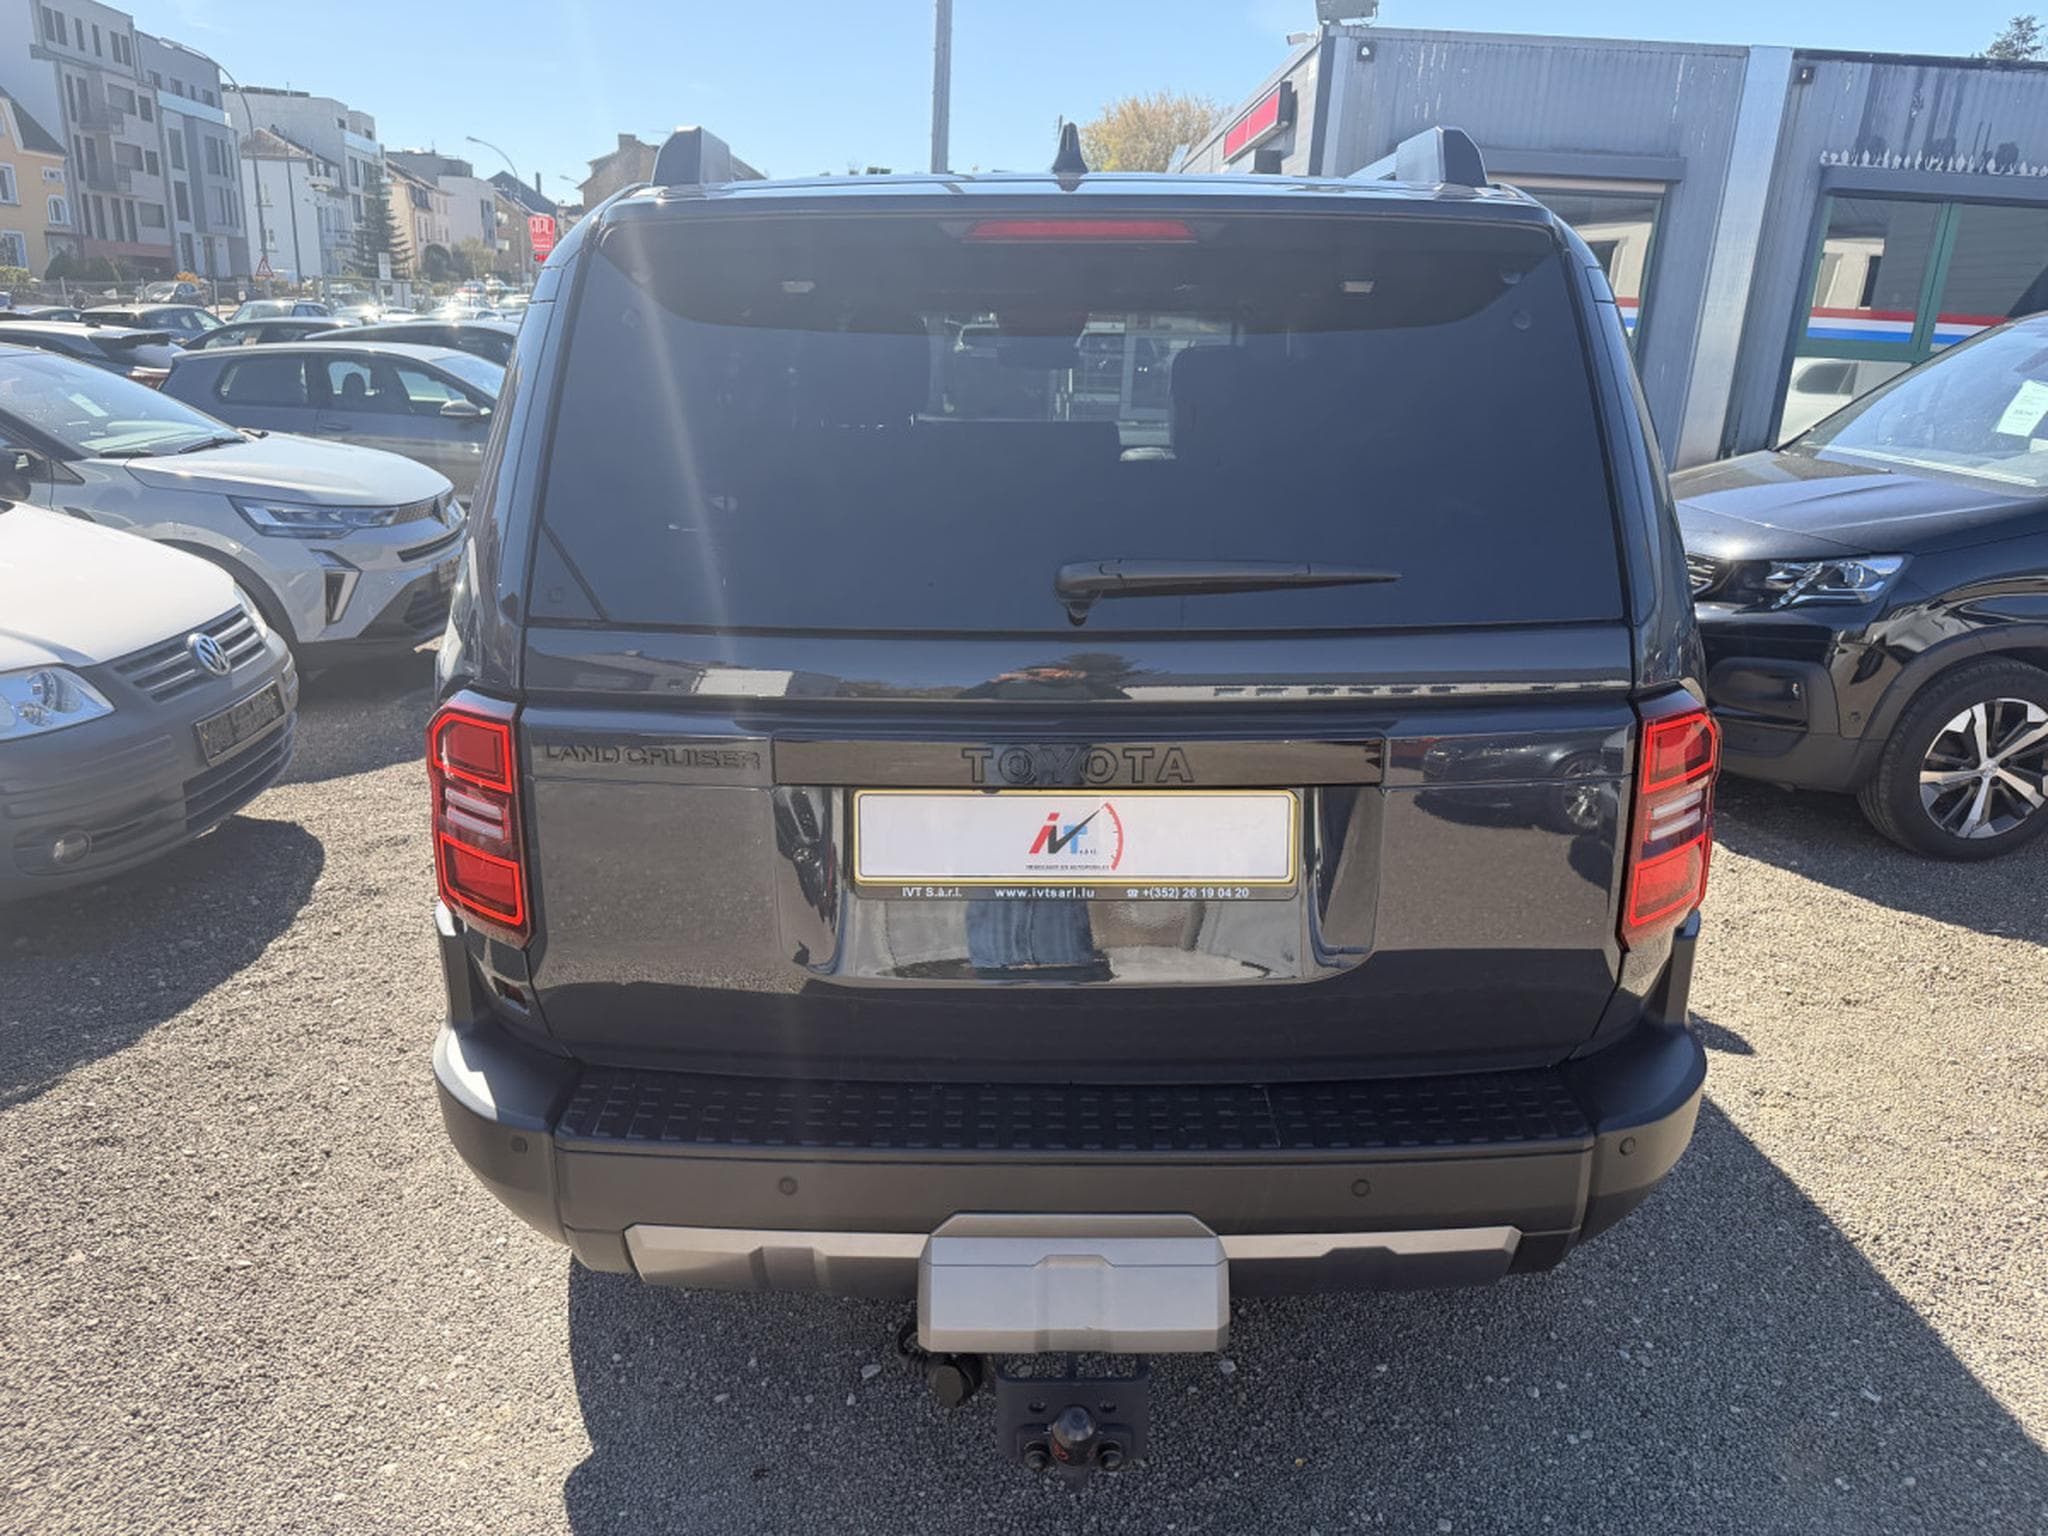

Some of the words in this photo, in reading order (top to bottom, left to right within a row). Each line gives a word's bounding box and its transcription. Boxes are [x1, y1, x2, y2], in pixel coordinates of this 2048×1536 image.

[546, 745, 620, 764] LAND
[626, 747, 761, 770] CRUISER
[961, 747, 1194, 785] TOYOTA
[902, 887, 922, 897] IVT
[994, 887, 1096, 898] www.ivtsarl.lu
[1143, 887, 1179, 898] +(352)
[1182, 887, 1197, 898] 26
[1201, 887, 1215, 898] 19
[1217, 887, 1232, 898] 04
[1235, 887, 1250, 898] 20
